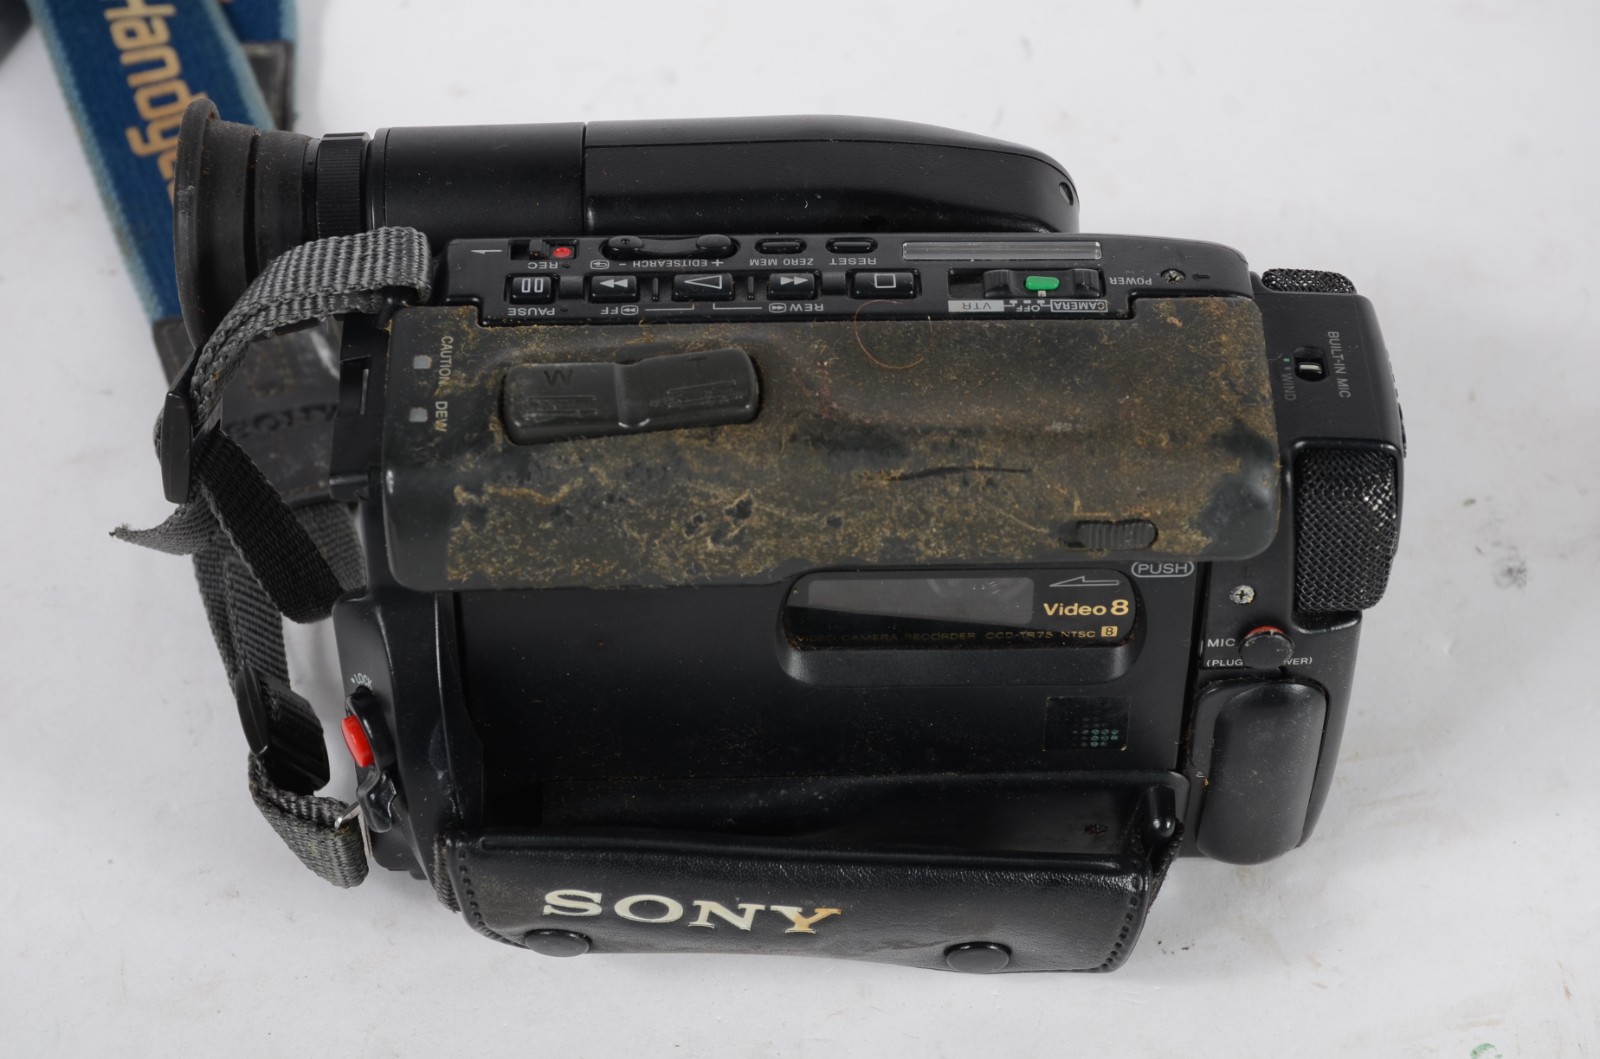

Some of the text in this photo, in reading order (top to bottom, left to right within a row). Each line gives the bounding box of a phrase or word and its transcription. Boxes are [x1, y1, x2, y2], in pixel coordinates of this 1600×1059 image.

[528, 261, 558, 270] REC
[632, 259, 708, 268] EDITSEARCH
[750, 257, 814, 266] ZERO MEM
[829, 257, 877, 265] RESET
[1109, 276, 1153, 286] POWER
[600, 307, 618, 315] FF
[789, 303, 824, 312] REW
[962, 301, 992, 311] VTR
[1016, 304, 1041, 312] OFF
[1053, 301, 1107, 311] CAMERA
[507, 307, 555, 316] PAUSE
[438, 335, 454, 388] CAUTION
[1327, 331, 1352, 399] BUILT-IN MIC
[543, 369, 575, 388] W
[1281, 373, 1297, 401] WIND
[434, 400, 448, 432] DEW
[1137, 563, 1188, 575] PUSH
[841, 632, 898, 641] CAMERA
[985, 631, 1054, 640] CCD-TR75
[1061, 630, 1096, 639] NTSC
[1207, 638, 1236, 648] MIC
[1206, 659, 1244, 667] (PLUG
[543, 889, 844, 935] SONY
